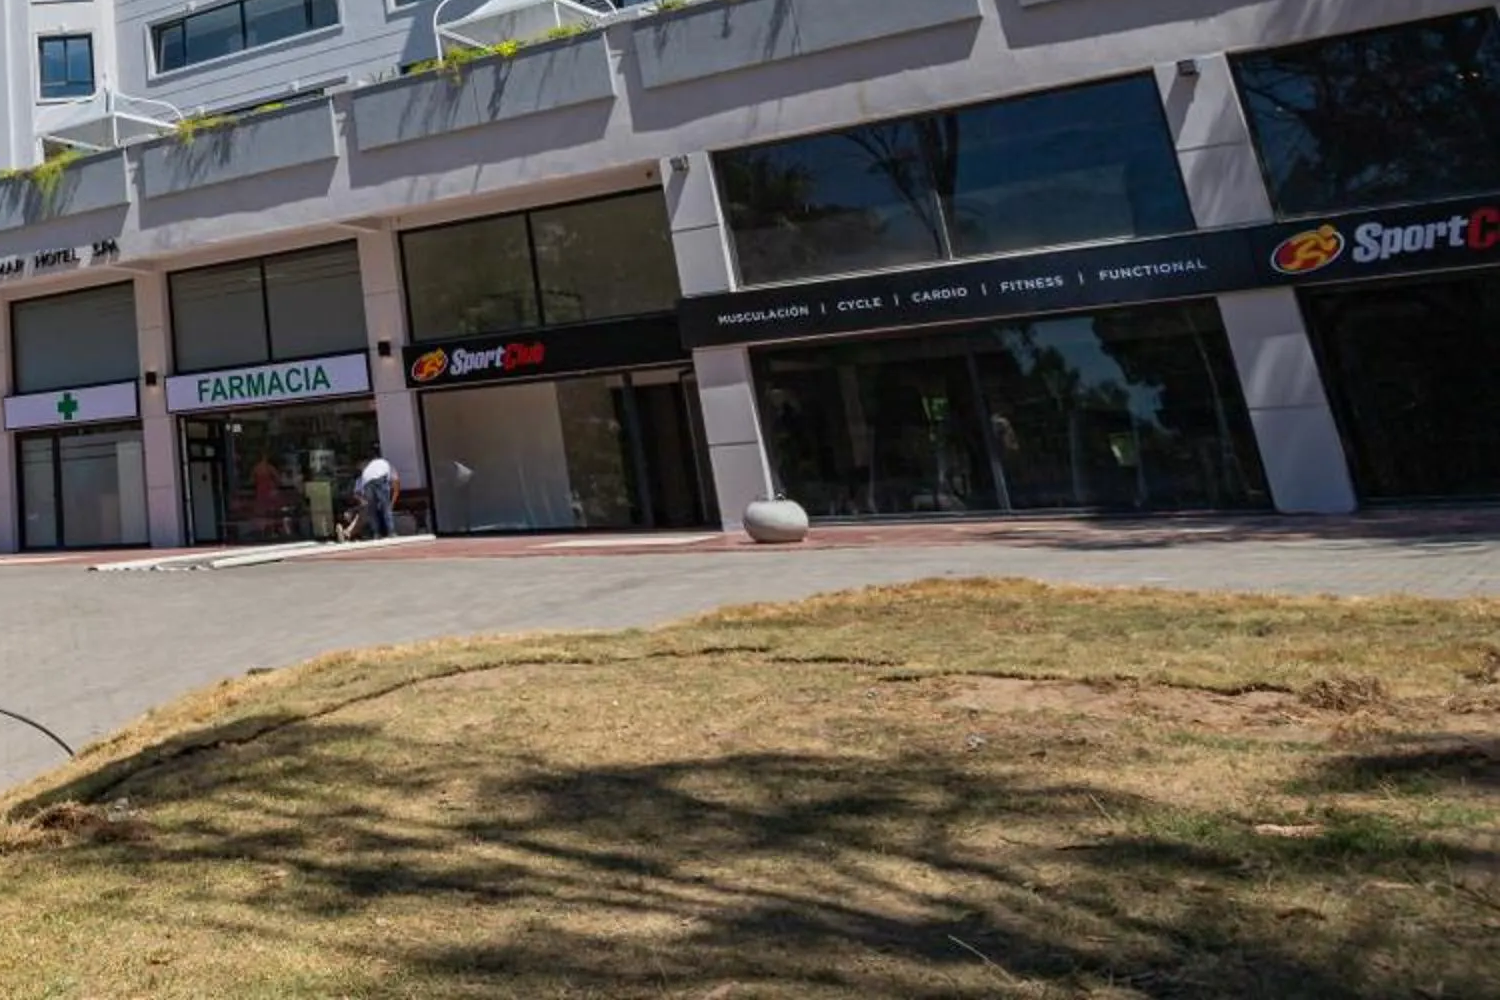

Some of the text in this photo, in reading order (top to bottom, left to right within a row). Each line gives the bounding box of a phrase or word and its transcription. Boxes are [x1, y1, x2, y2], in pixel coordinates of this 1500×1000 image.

[35, 247, 81, 269] HOTEL
[717, 258, 1208, 326] MUSCULACIÓN CYCLE CARDIO FITNESS FUNCTIONAL
[197, 364, 332, 404] FARMACIA
